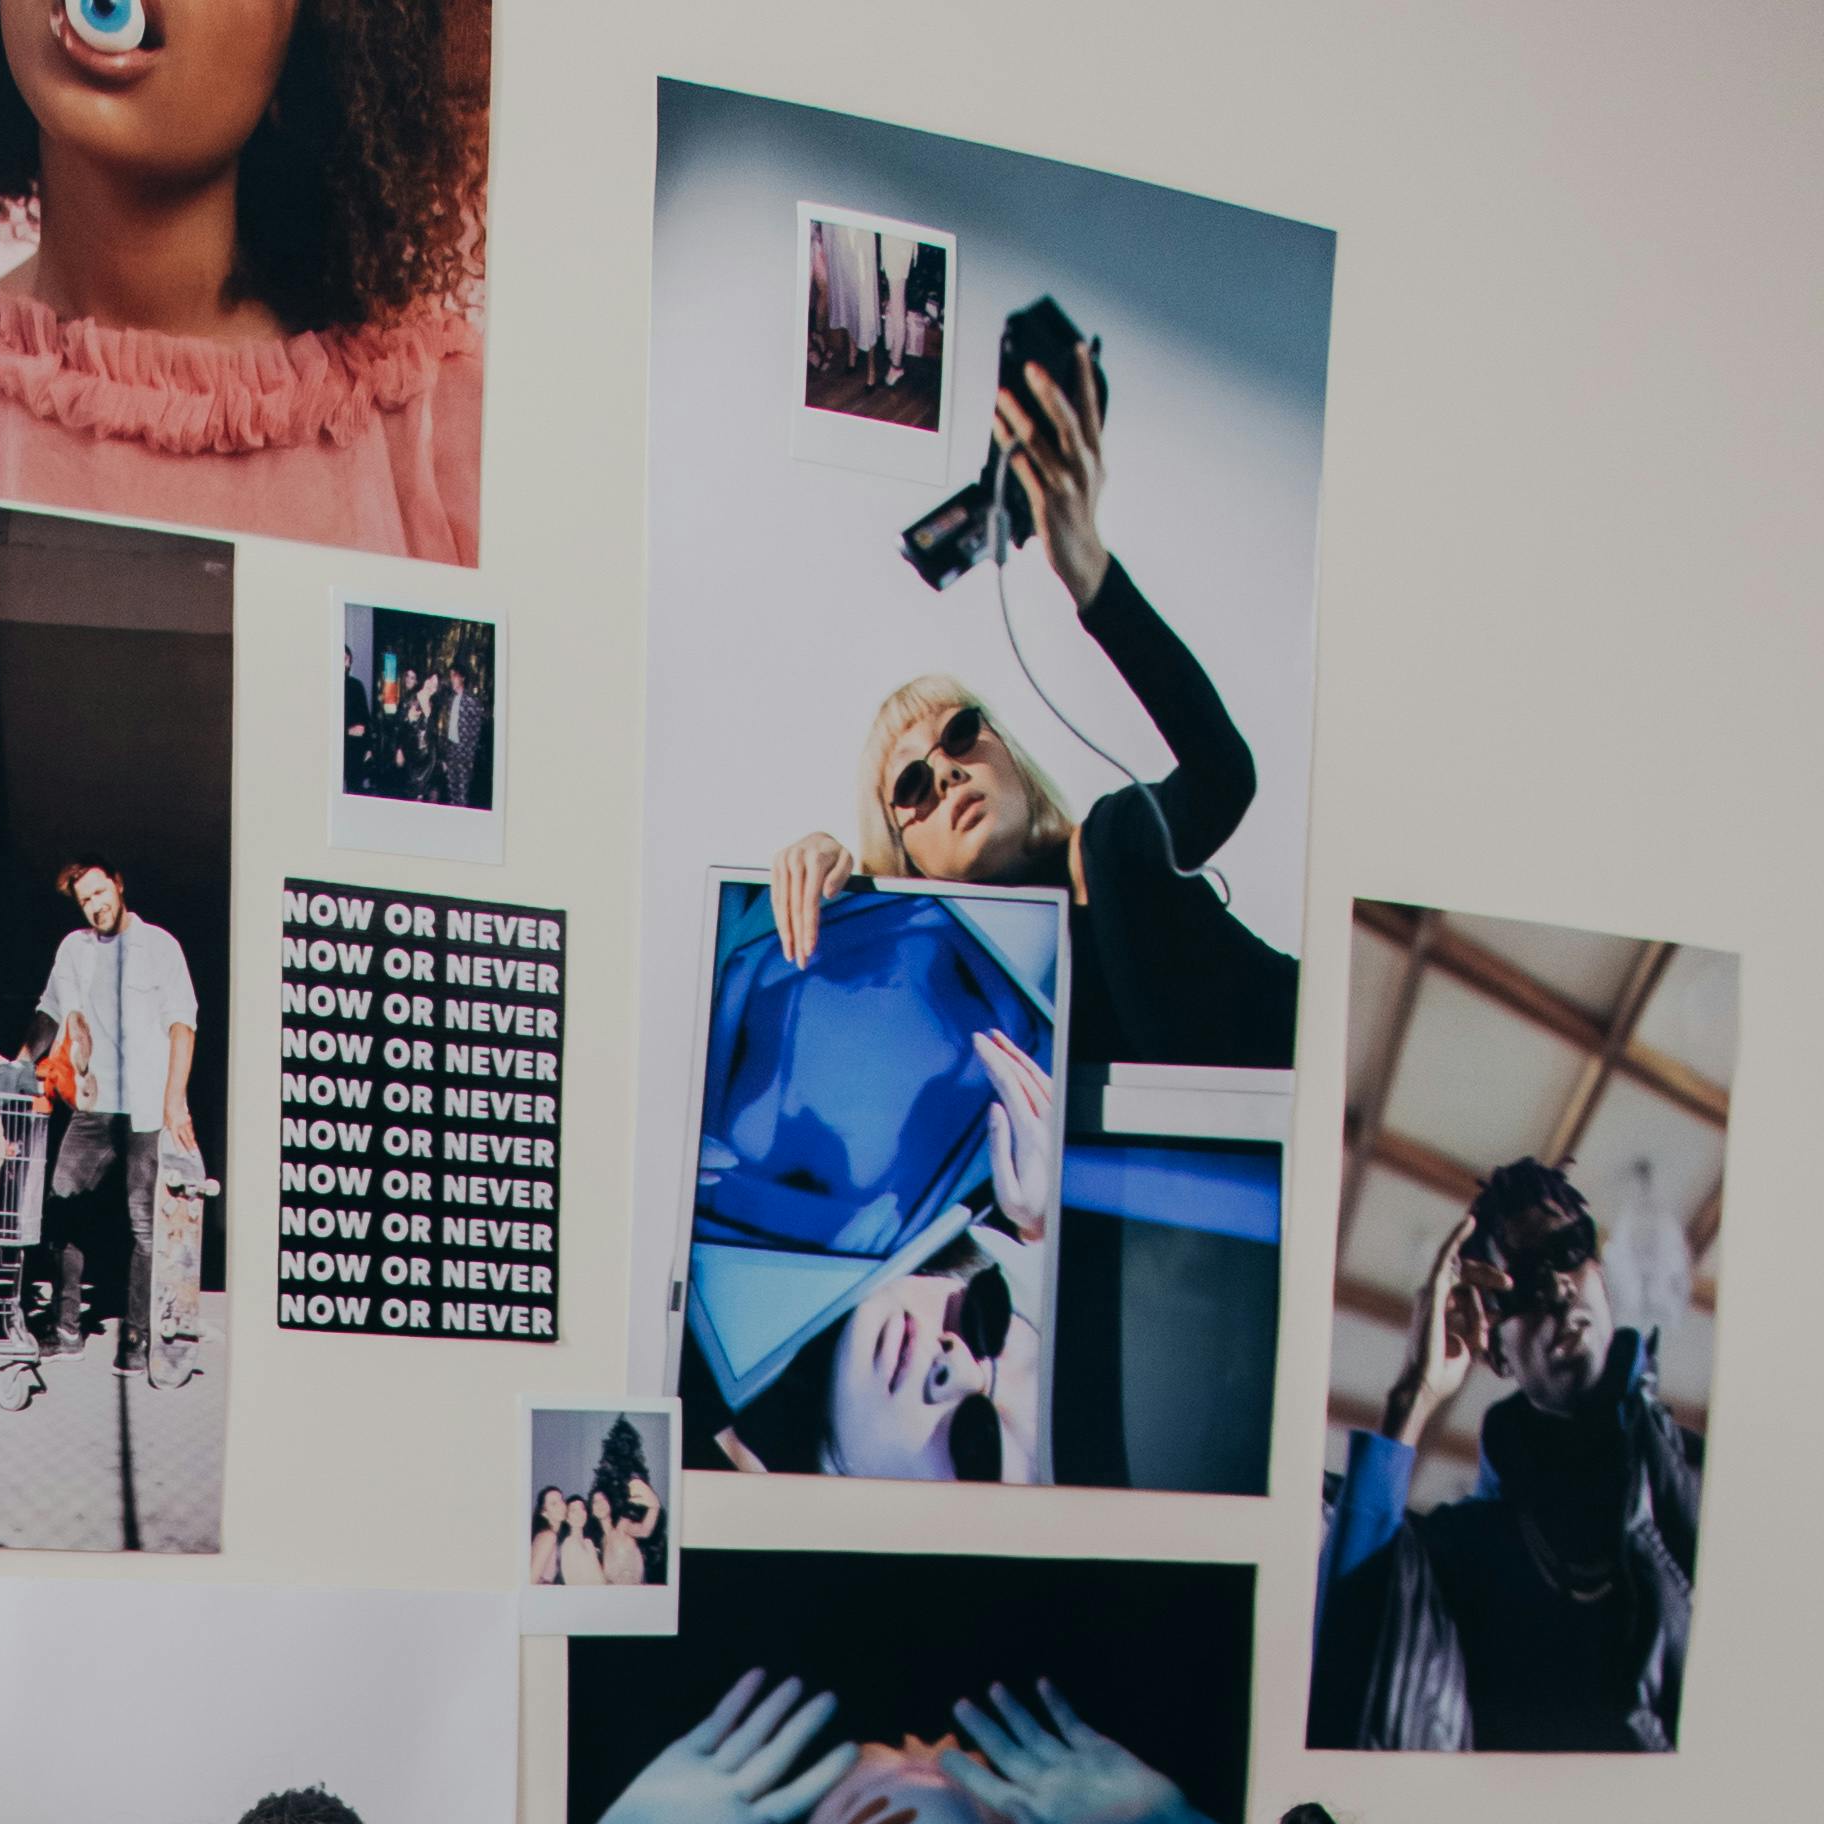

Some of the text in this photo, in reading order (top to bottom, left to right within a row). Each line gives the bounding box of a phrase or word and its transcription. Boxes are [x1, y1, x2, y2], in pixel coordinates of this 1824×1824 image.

[282, 891, 561, 951] NOW OR NEVER
[282, 937, 560, 995] NOW OR NEVER
[282, 983, 558, 1039] NOW OR NEVER
[282, 1028, 557, 1082] NOW OR NEVER
[282, 1073, 556, 1125] NOW OR NEVER
[281, 1118, 555, 1168] NOW OR NEVER
[281, 1163, 554, 1210] NOW OR NEVER
[281, 1207, 553, 1253] NOW OR NEVER
[280, 1251, 553, 1294] NOW OR NEVER
[280, 1294, 553, 1335] NOW OR NEVER
